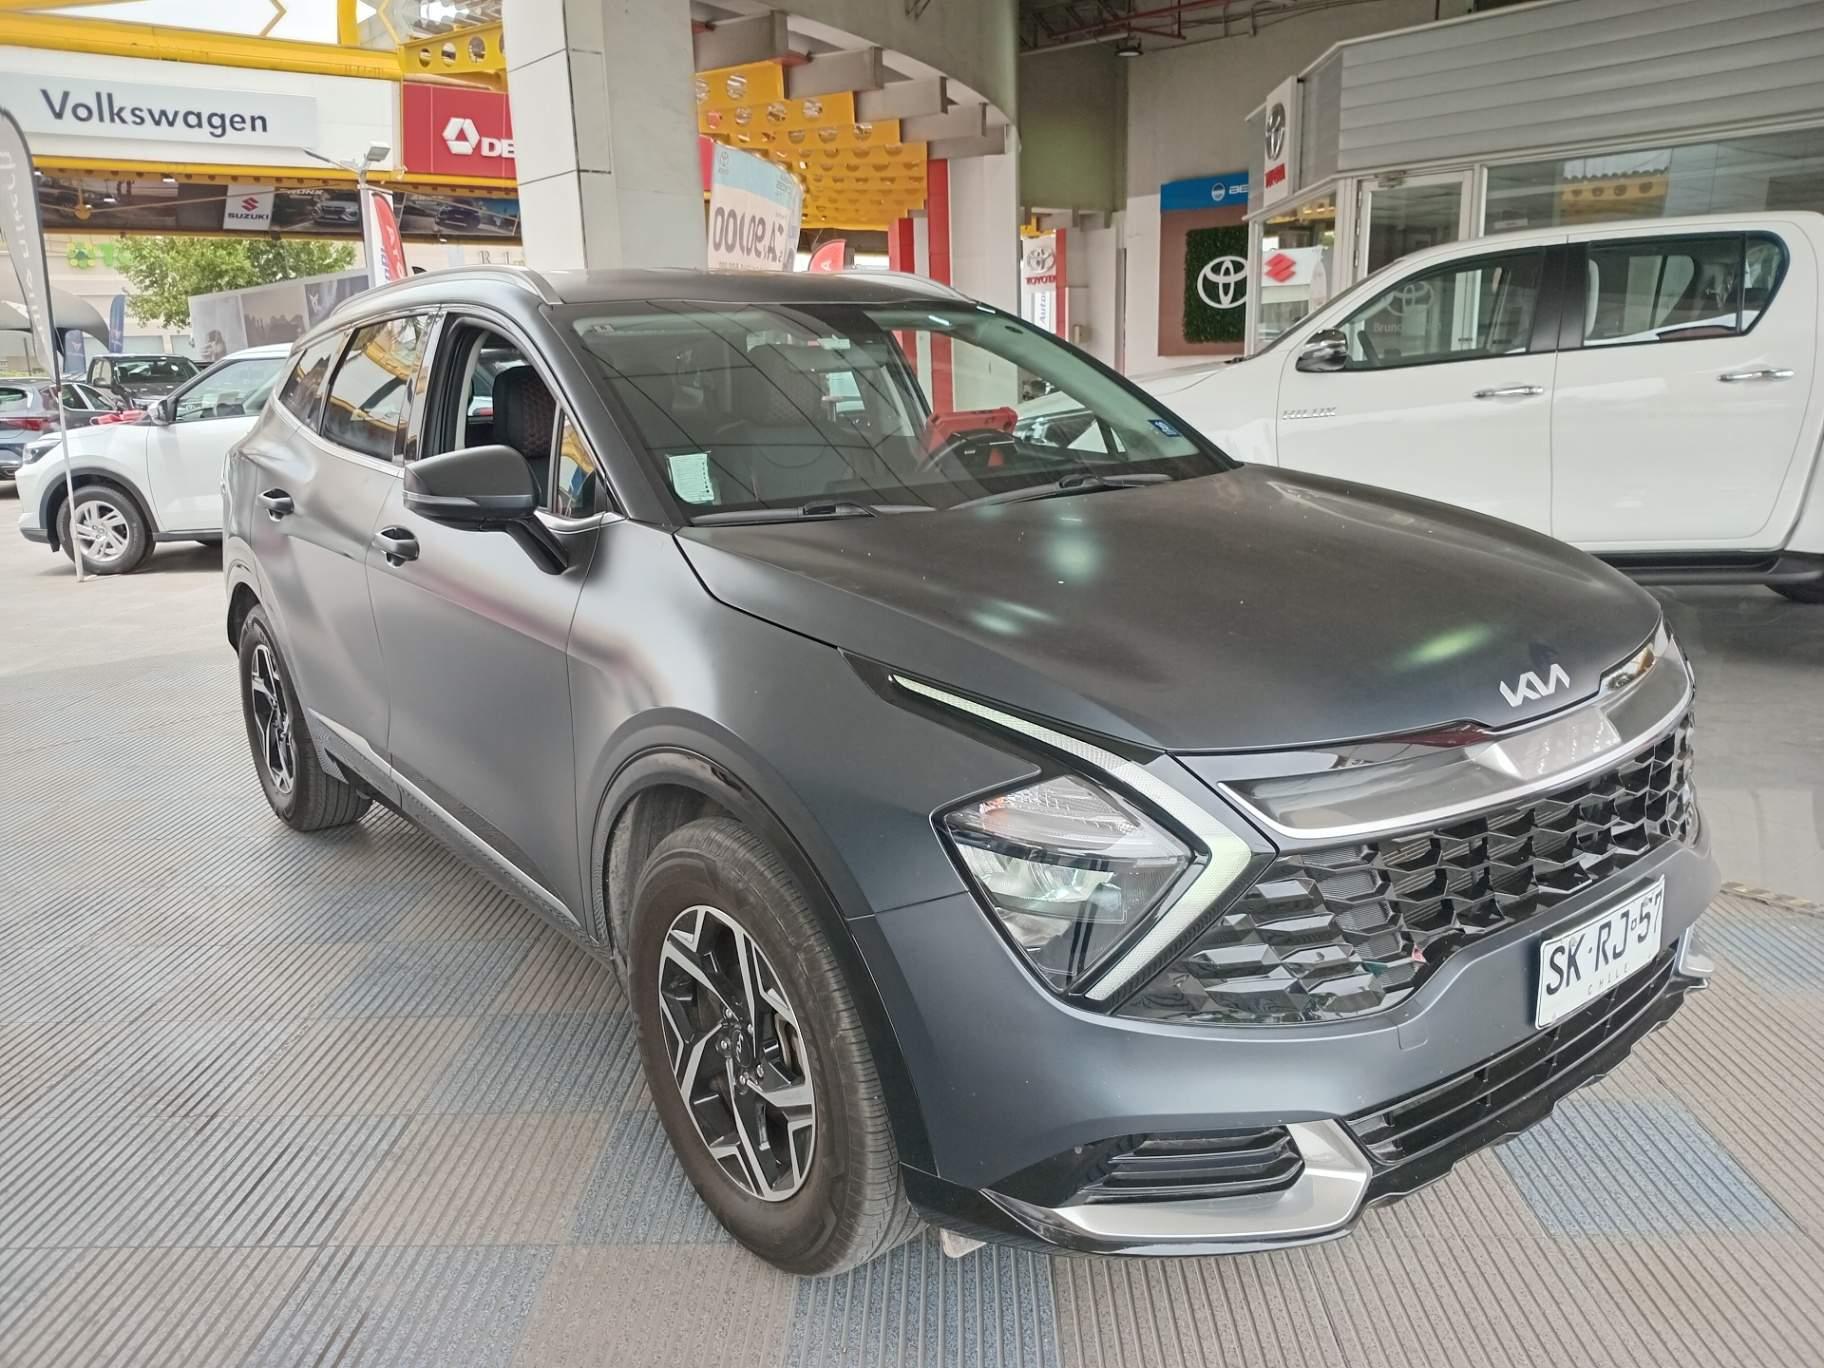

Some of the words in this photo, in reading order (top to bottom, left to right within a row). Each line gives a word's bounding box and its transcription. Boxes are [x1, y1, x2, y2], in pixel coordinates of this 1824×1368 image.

[40, 88, 268, 138] Volkswagen
[227, 212, 269, 220] SUZUKI
[1282, 407, 1336, 421] HILUX
[1499, 663, 1570, 708] KIA
[1587, 962, 1629, 995] CHILE
